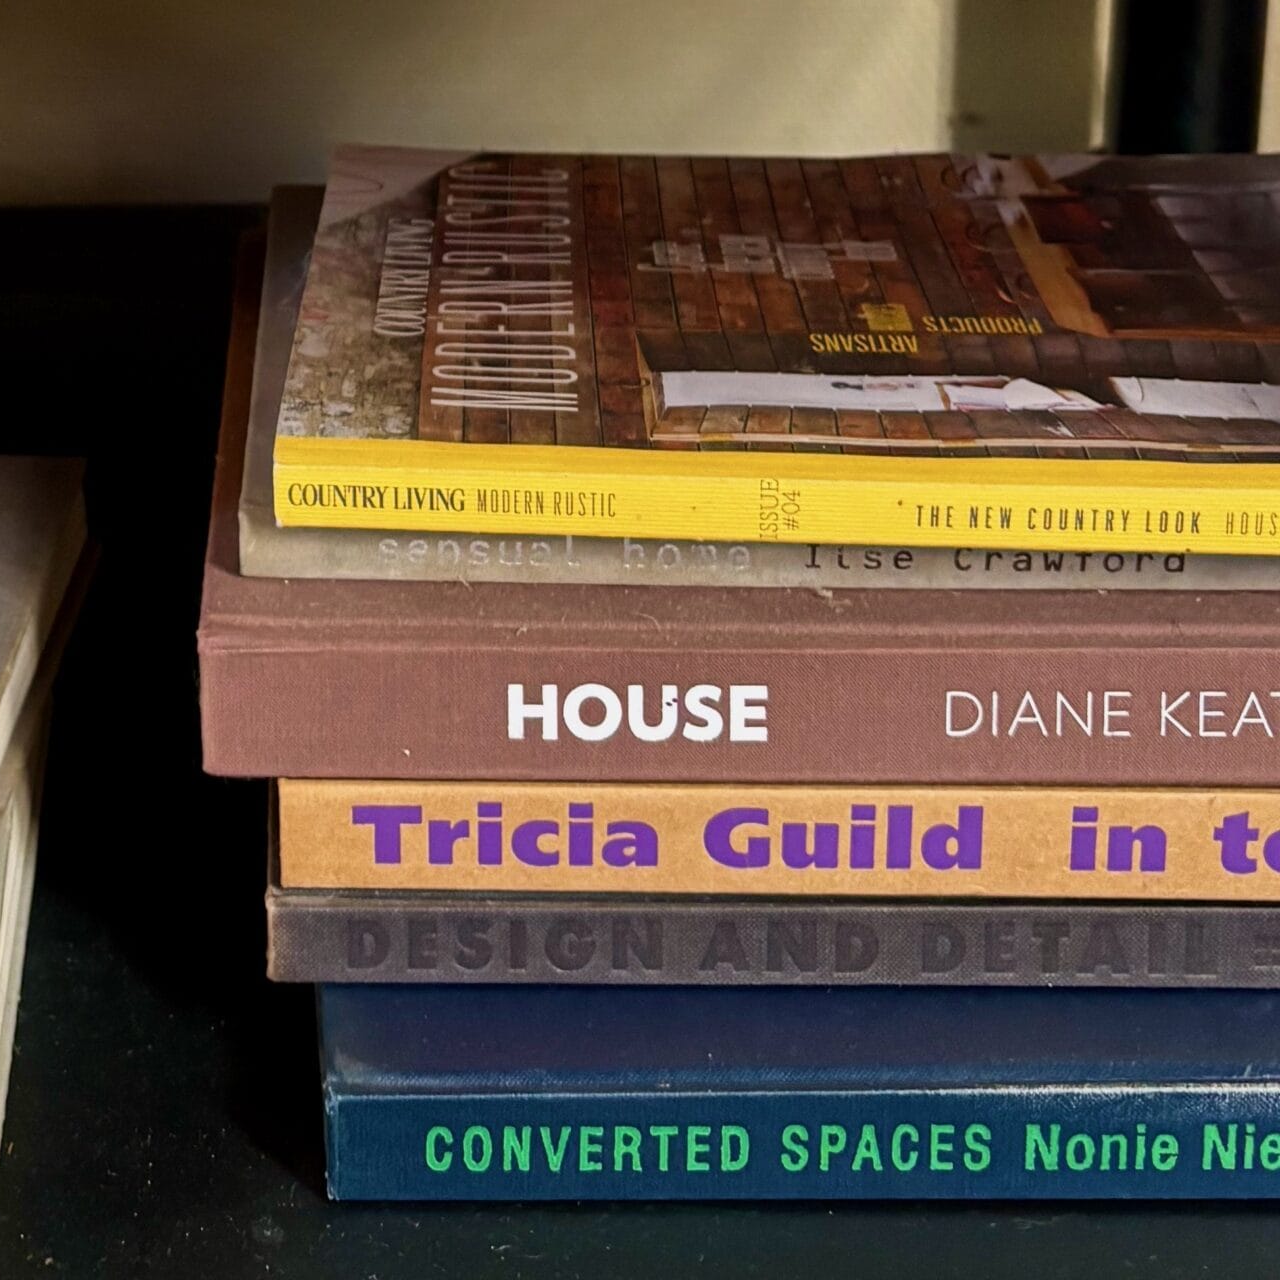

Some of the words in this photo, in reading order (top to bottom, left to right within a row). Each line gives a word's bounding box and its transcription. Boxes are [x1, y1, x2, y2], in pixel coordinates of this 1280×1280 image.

[439, 166, 572, 264] RUSTIC
[430, 280, 578, 412] MODERN
[809, 333, 919, 354] ARTISANS
[924, 315, 1044, 335] PRODUCTS
[287, 482, 388, 510] COUNTRY
[393, 486, 466, 513] LIVING
[477, 489, 544, 515] MODERN
[553, 491, 617, 519] RUSTIC
[759, 478, 780, 540] ISSUE
[781, 489, 802, 532] #04
[915, 505, 954, 528] THE
[969, 507, 1013, 531] NEW
[1027, 509, 1130, 533] COUNTRY
[1145, 510, 1201, 535] LOOK
[1225, 511, 1278, 536] HOUS
[378, 535, 581, 567] sensual
[622, 536, 751, 570] home
[507, 683, 770, 742] HOUSE
[945, 690, 1132, 739] DIANE
[351, 801, 659, 867] Tricia
[702, 804, 985, 870] Guild
[1069, 805, 1168, 873] in
[346, 918, 665, 972] DESIGN
[698, 920, 881, 975] AND
[919, 921, 1219, 978] DETAIL
[425, 1125, 751, 1173] CONVERTED
[780, 1124, 993, 1173] SPACES
[1024, 1123, 1180, 1172] Nonie
